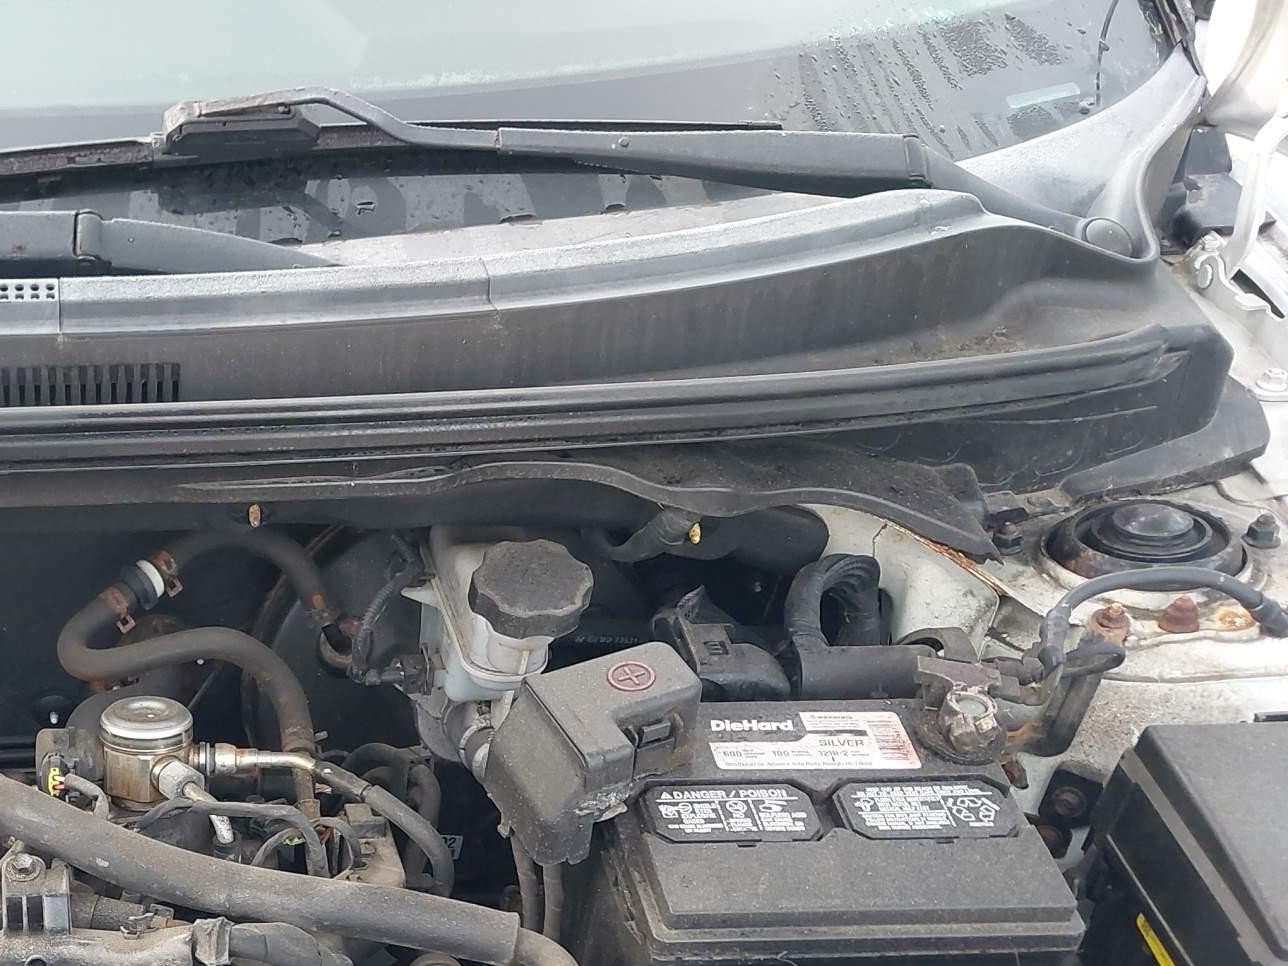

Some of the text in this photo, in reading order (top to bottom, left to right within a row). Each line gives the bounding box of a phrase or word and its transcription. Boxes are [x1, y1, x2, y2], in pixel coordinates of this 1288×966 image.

[710, 719, 794, 732] DieHard
[818, 739, 865, 747] SILVER
[672, 789, 726, 800] DANGER
[739, 788, 788, 799] POISON
